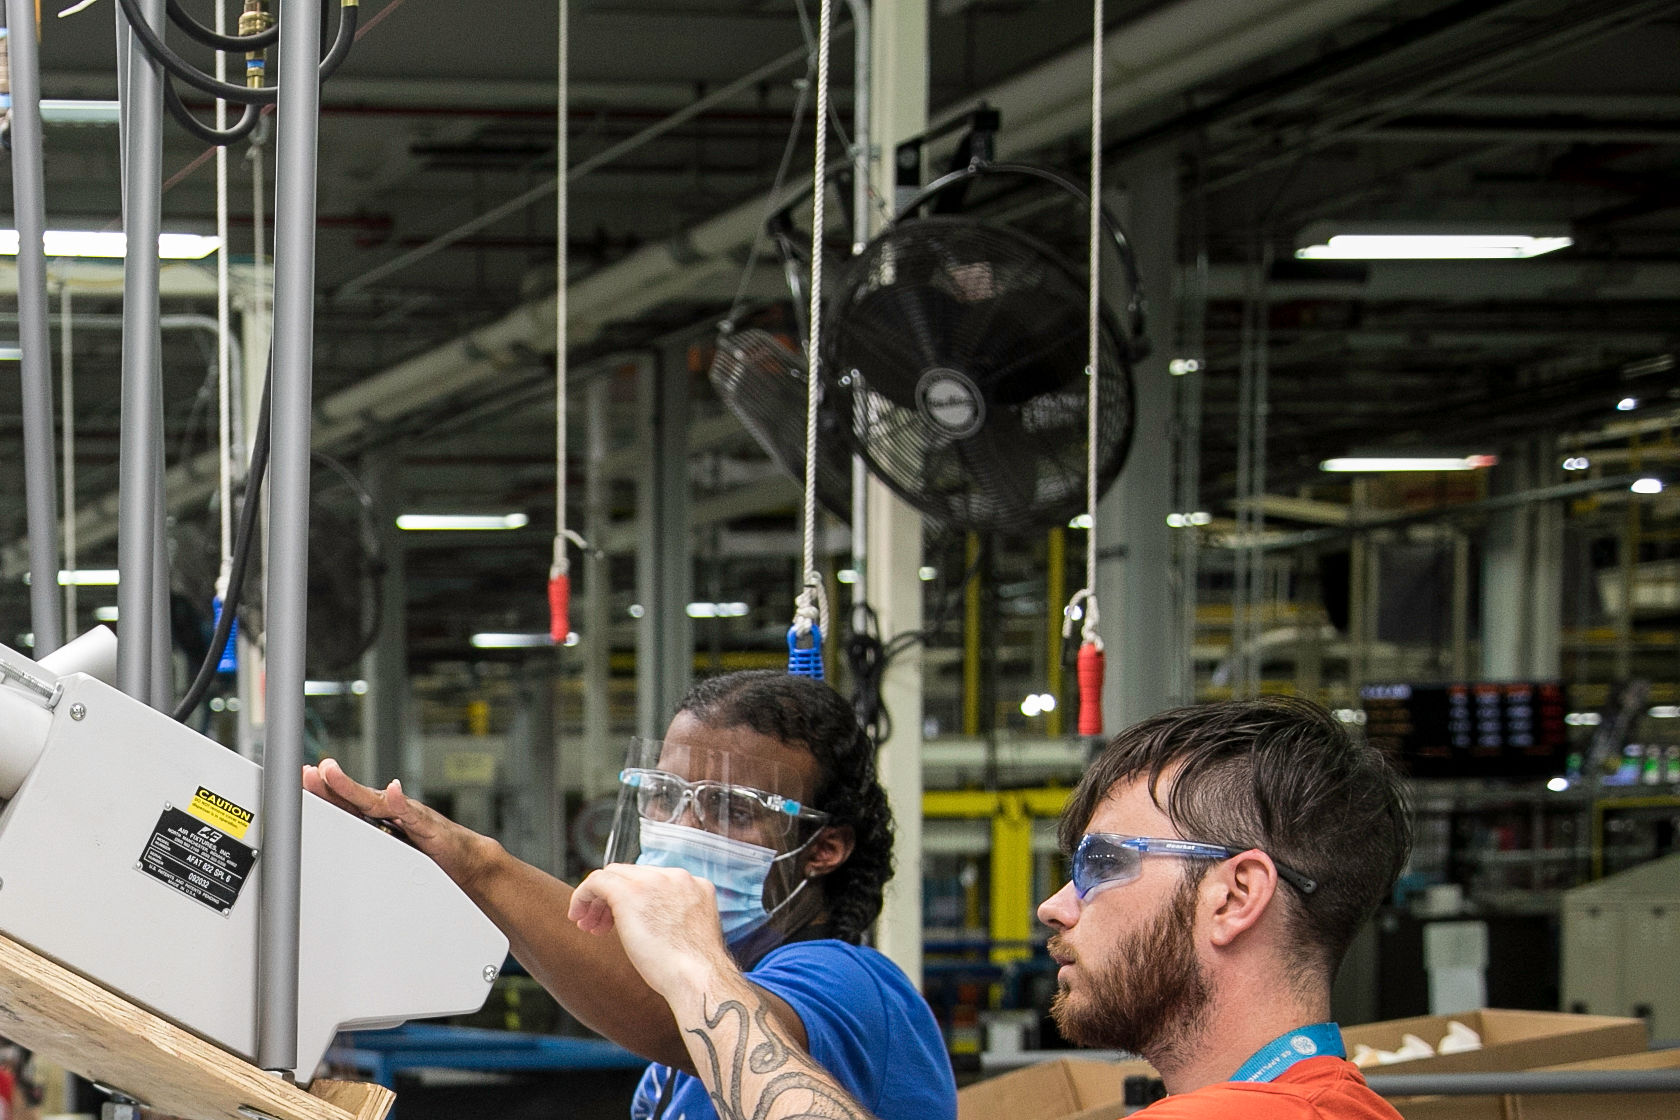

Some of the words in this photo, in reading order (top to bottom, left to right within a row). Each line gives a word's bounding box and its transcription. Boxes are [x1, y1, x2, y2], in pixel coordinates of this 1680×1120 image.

[199, 790, 250, 821] CAUTION
[154, 840, 171, 851] NUMBER
[156, 837, 169, 846] MODEL
[178, 827, 189, 836] AIR
[190, 833, 217, 852] FIXTURES,
[219, 849, 230, 859] INC.
[148, 855, 164, 865] NUMBER
[150, 851, 162, 860] SERIAL
[186, 854, 203, 867] AFAT
[213, 869, 224, 880] SPL
[158, 869, 174, 880] PATENTS
[185, 883, 201, 894] PATENTS
[202, 892, 219, 904] PENDING
[168, 879, 179, 888] MADE
[188, 872, 210, 889] 092032
